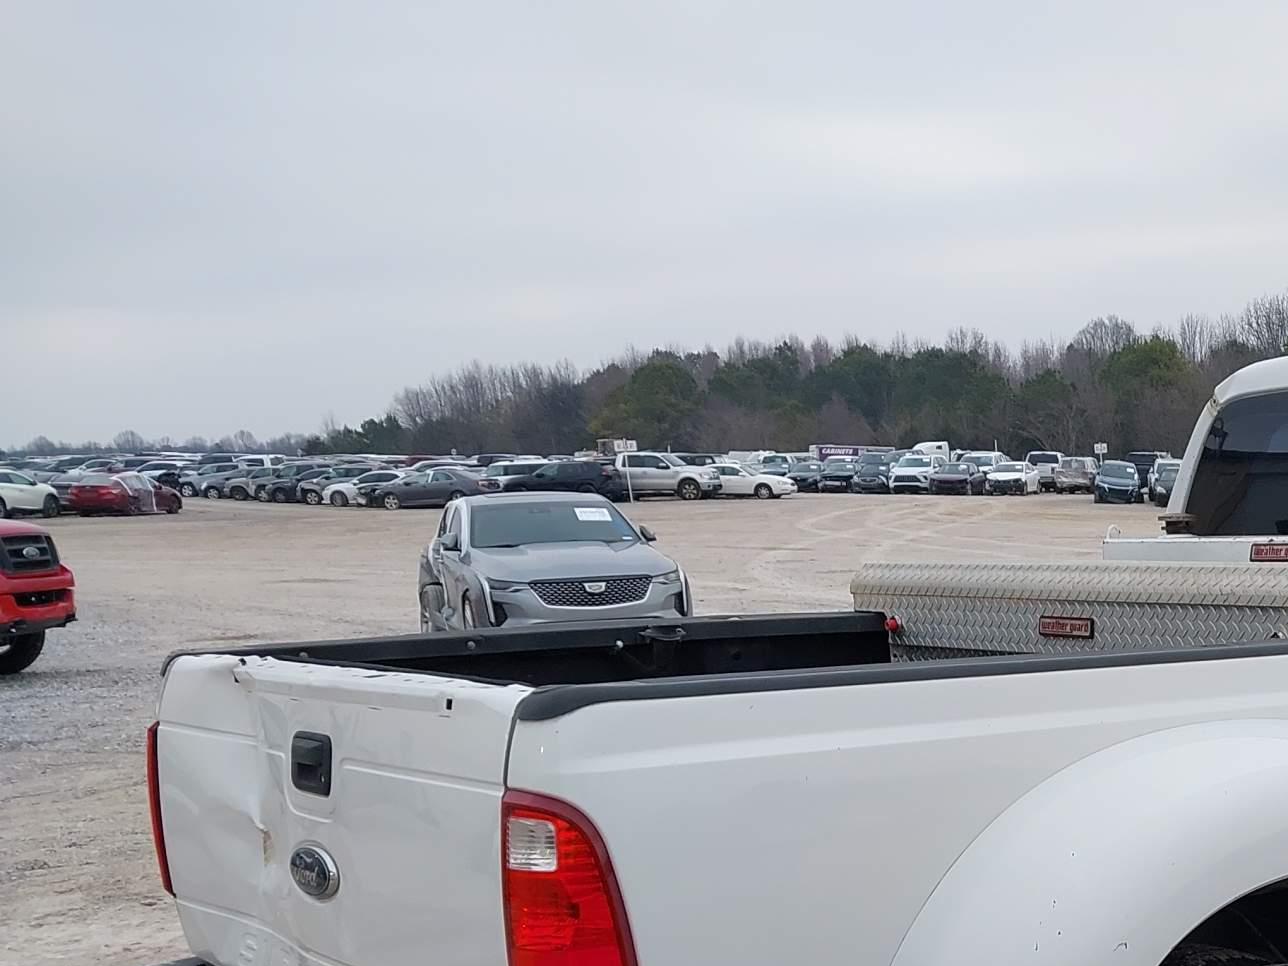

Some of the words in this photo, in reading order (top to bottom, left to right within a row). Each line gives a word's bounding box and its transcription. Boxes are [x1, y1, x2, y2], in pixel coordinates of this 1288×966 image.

[1253, 545, 1283, 556] weather
[1041, 620, 1069, 631] weather
[1069, 622, 1088, 634] guard
